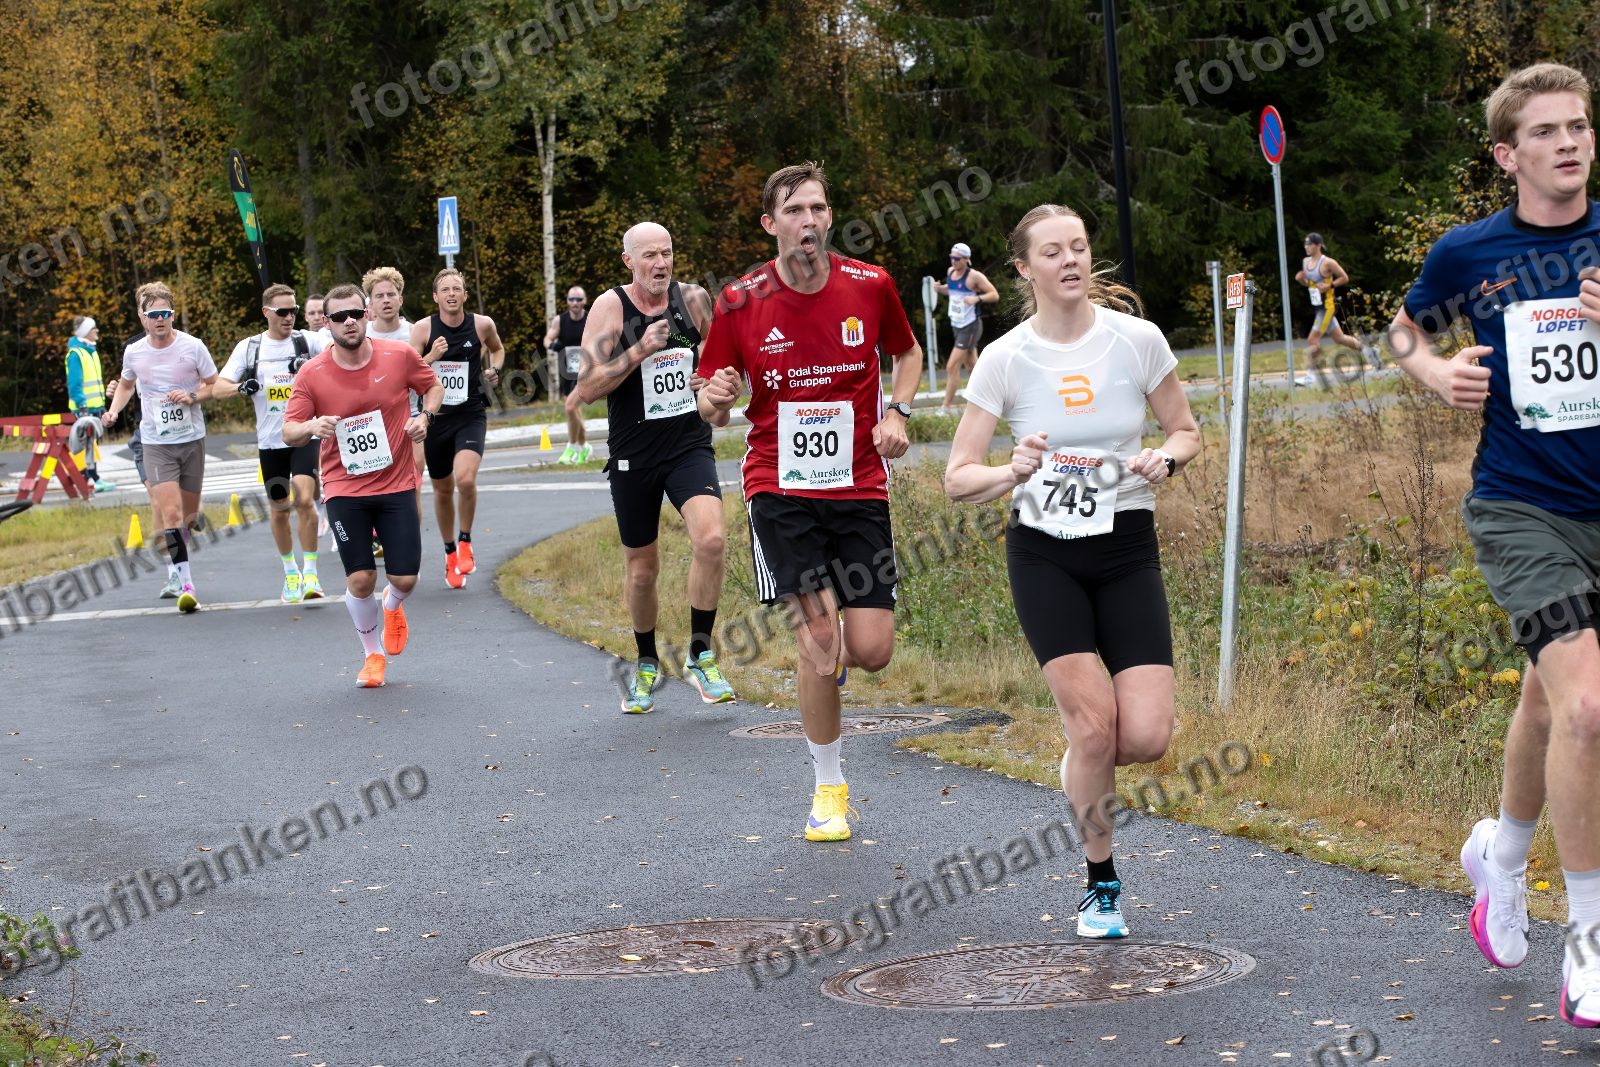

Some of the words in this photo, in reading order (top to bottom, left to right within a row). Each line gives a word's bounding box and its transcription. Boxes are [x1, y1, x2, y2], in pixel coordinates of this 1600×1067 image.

[841, 265, 861, 275] REMA
[862, 269, 879, 279] 1000
[1537, 319, 1588, 334] LØPET
[652, 352, 685, 363] NORGES
[1531, 341, 1598, 384] 530
[787, 367, 811, 379] Odal
[812, 361, 866, 377] Sparebank
[654, 370, 686, 394] 603
[788, 376, 832, 389] Gruppen
[161, 408, 184, 424] 949
[796, 407, 841, 417] NORGES
[799, 416, 833, 426] LØPET
[347, 432, 378, 454] 389
[793, 430, 839, 458] 930
[1050, 452, 1104, 468] NORGES
[809, 467, 850, 478] Aurskog
[1053, 464, 1095, 477] LØPET
[1042, 479, 1099, 518] 745
